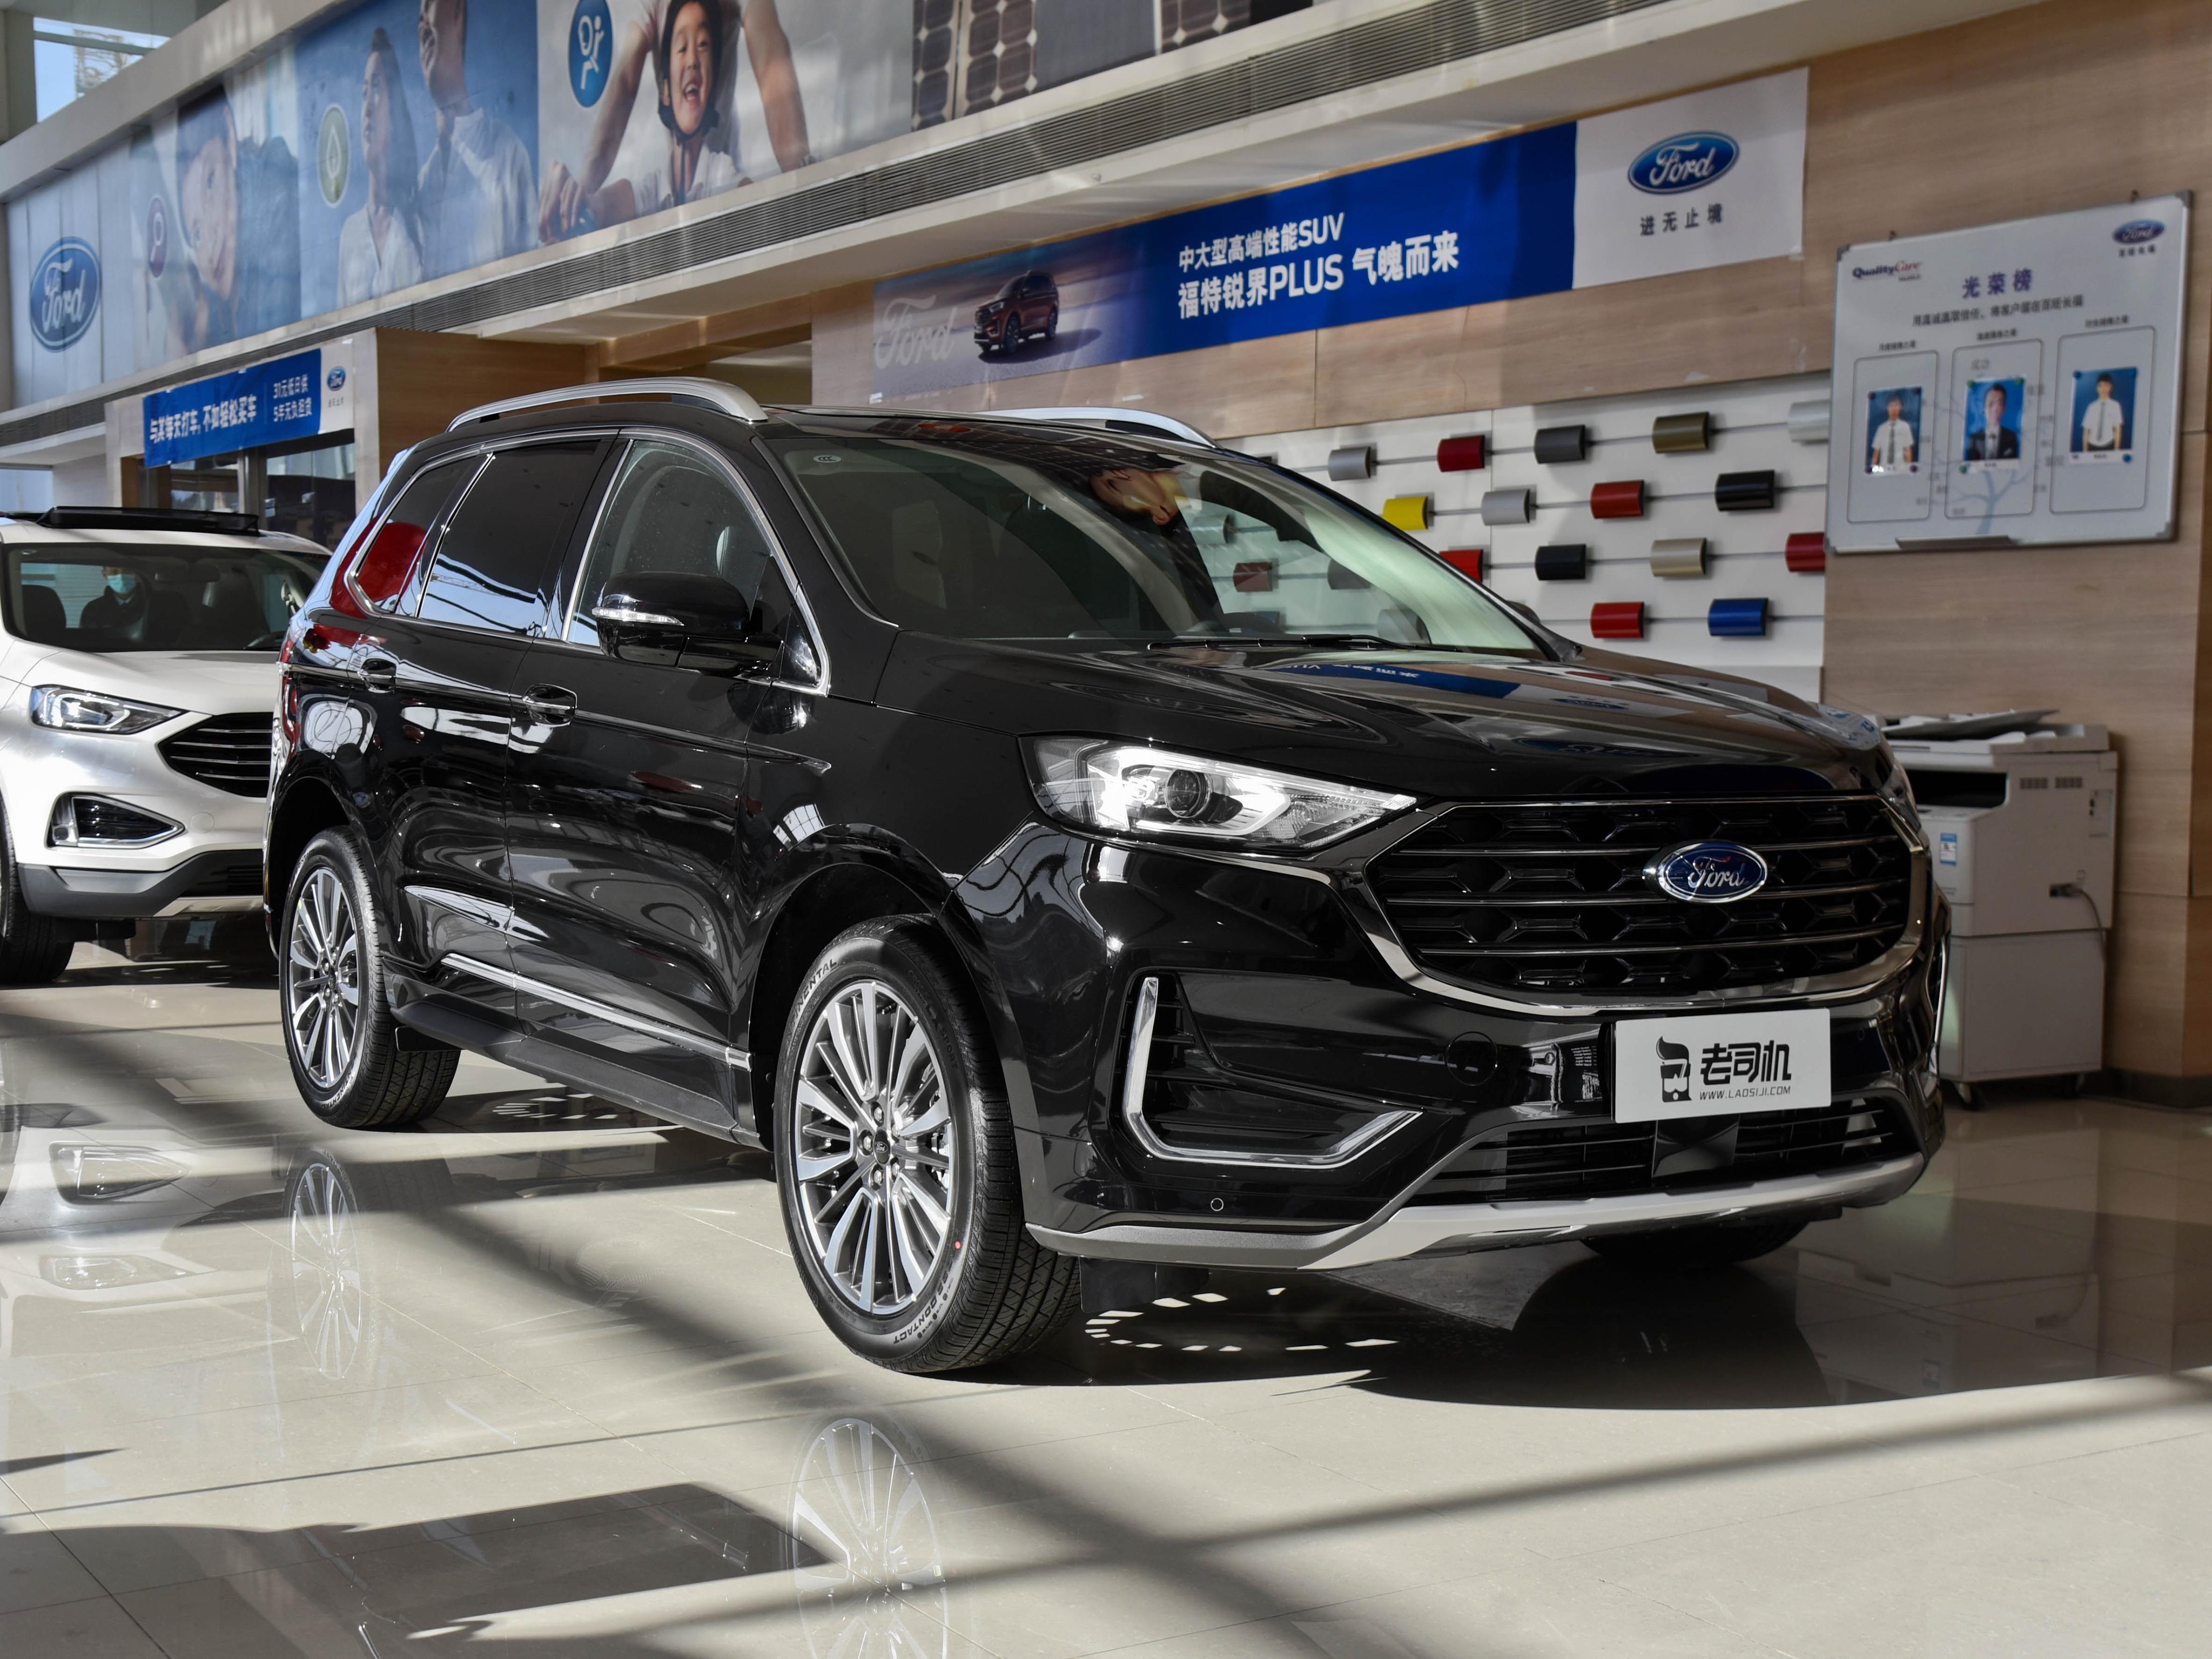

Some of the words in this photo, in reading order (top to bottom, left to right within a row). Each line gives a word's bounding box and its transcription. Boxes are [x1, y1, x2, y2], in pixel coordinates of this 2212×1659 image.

[1649, 142, 1716, 186] Ford
[1179, 212, 1344, 272] 中大型高端性能SUV
[1639, 203, 1723, 236] 进无止境
[42, 257, 86, 333] Ford
[1178, 254, 1344, 319] 福特锐界PLUS
[1352, 230, 1459, 286] 气魄而来
[1962, 267, 2032, 299] 光荣榜
[874, 294, 958, 370] Ford
[1688, 856, 1746, 888] Ford
[1700, 1040, 1792, 1086] 老司机
[1699, 1085, 1791, 1100] WWW.LAOSIJI.COM
[893, 1295, 936, 1344] CONTACT
